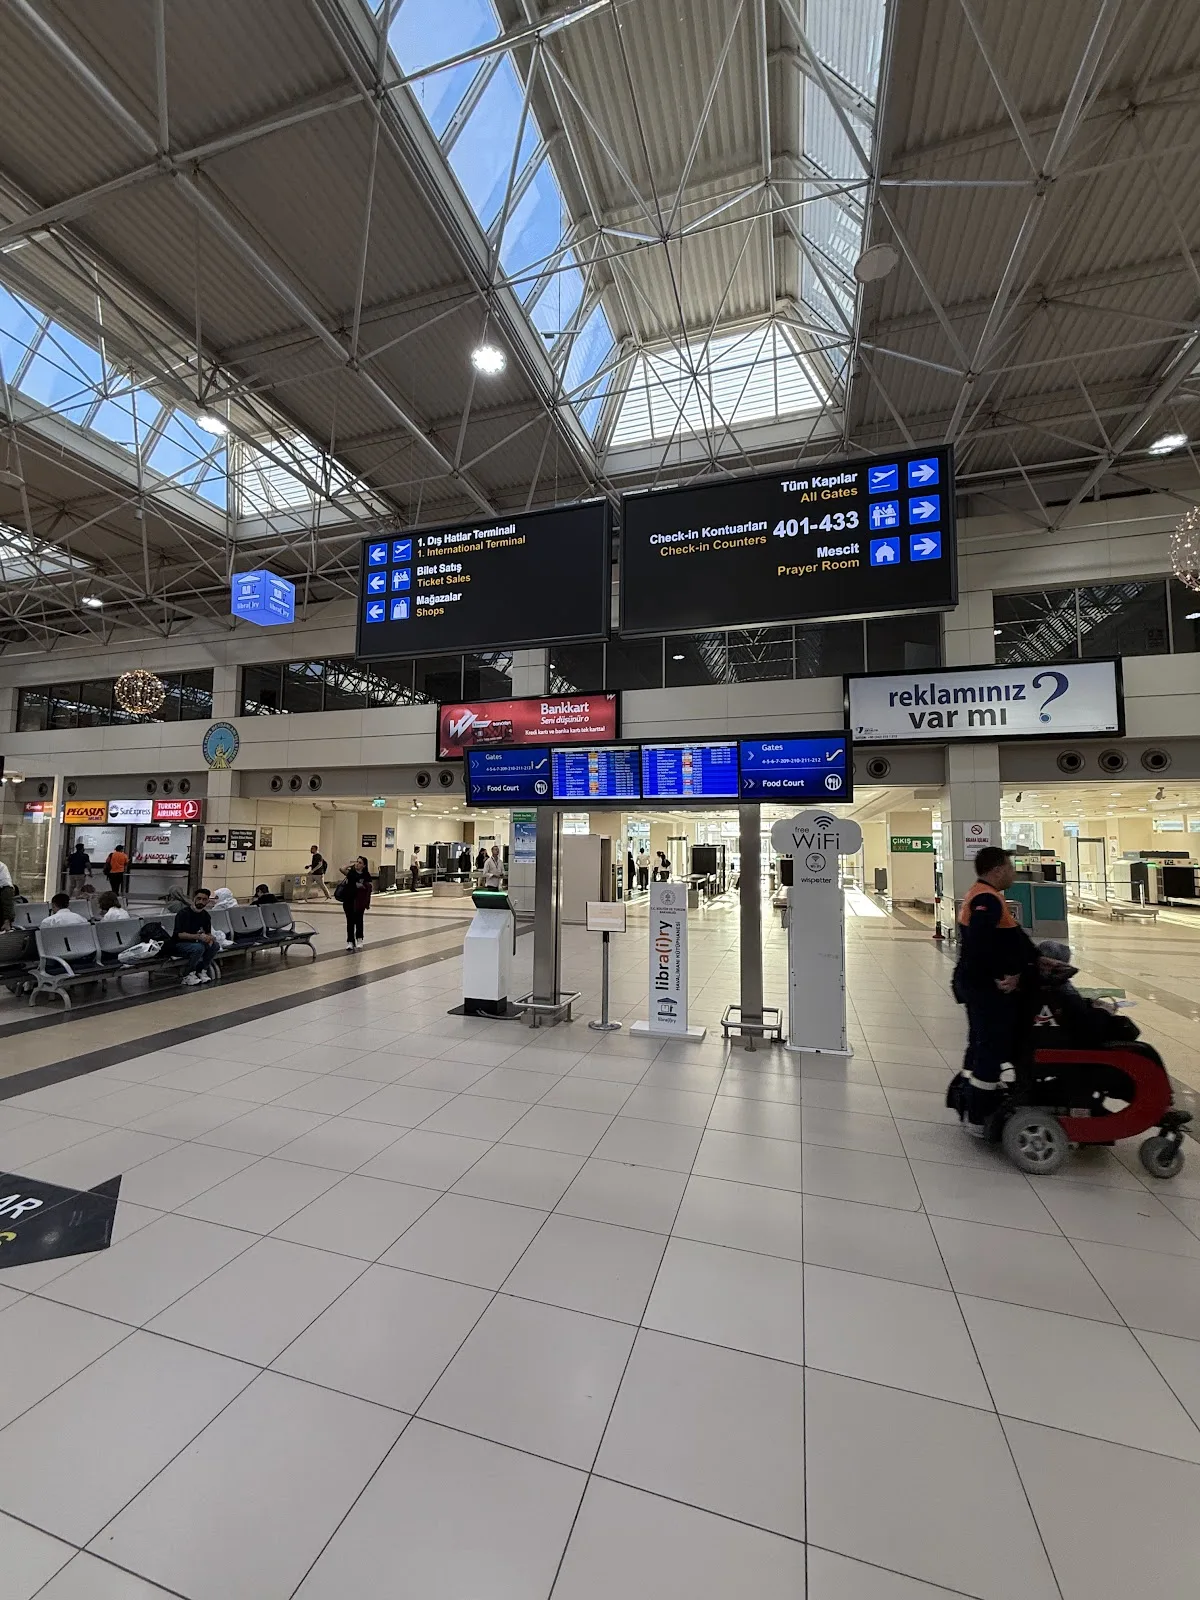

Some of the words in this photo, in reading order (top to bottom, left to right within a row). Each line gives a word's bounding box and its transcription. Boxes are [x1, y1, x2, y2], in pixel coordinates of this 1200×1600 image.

[781, 479, 809, 492] Tüm
[812, 472, 858, 490] Kapılar
[800, 492, 817, 503] All
[820, 486, 858, 501] Gates
[649, 528, 699, 545] Check-in
[701, 520, 767, 538] Kontuarları
[773, 511, 859, 538] 401-433
[418, 536, 426, 547] 1.
[427, 534, 442, 548] Dış
[444, 530, 471, 544] Hatlar
[473, 524, 516, 541] Terminali
[417, 548, 425, 558] 1.
[427, 542, 484, 557] International
[486, 535, 526, 550] Terminal
[660, 541, 710, 557] Check-in
[713, 534, 767, 550] Counters
[817, 543, 860, 559] Mescit
[417, 564, 437, 576] Bilet
[439, 562, 462, 575] Satış
[777, 563, 818, 577] Prayer
[821, 558, 860, 570] Room
[417, 575, 444, 588] Ticket
[446, 573, 471, 585] Sales
[416, 592, 462, 605] Mağazalar
[416, 607, 445, 618] Shops
[889, 683, 1026, 708] reklamınız
[908, 708, 959, 729] var
[968, 707, 1007, 727] mı
[1032, 671, 1069, 724] ?
[540, 701, 590, 715] Bankkart
[540, 716, 555, 725] Seni
[556, 714, 584, 725] düşünür
[487, 784, 502, 792] Food
[762, 779, 781, 787] Food
[783, 779, 805, 787] Court
[66, 808, 105, 817] PEGASUS
[120, 808, 150, 817] SunExpress
[157, 802, 182, 810] TURKISH
[157, 809, 182, 817] AIRLINES
[792, 833, 840, 850] WiFi
[655, 920, 672, 990] libra(i)ry
